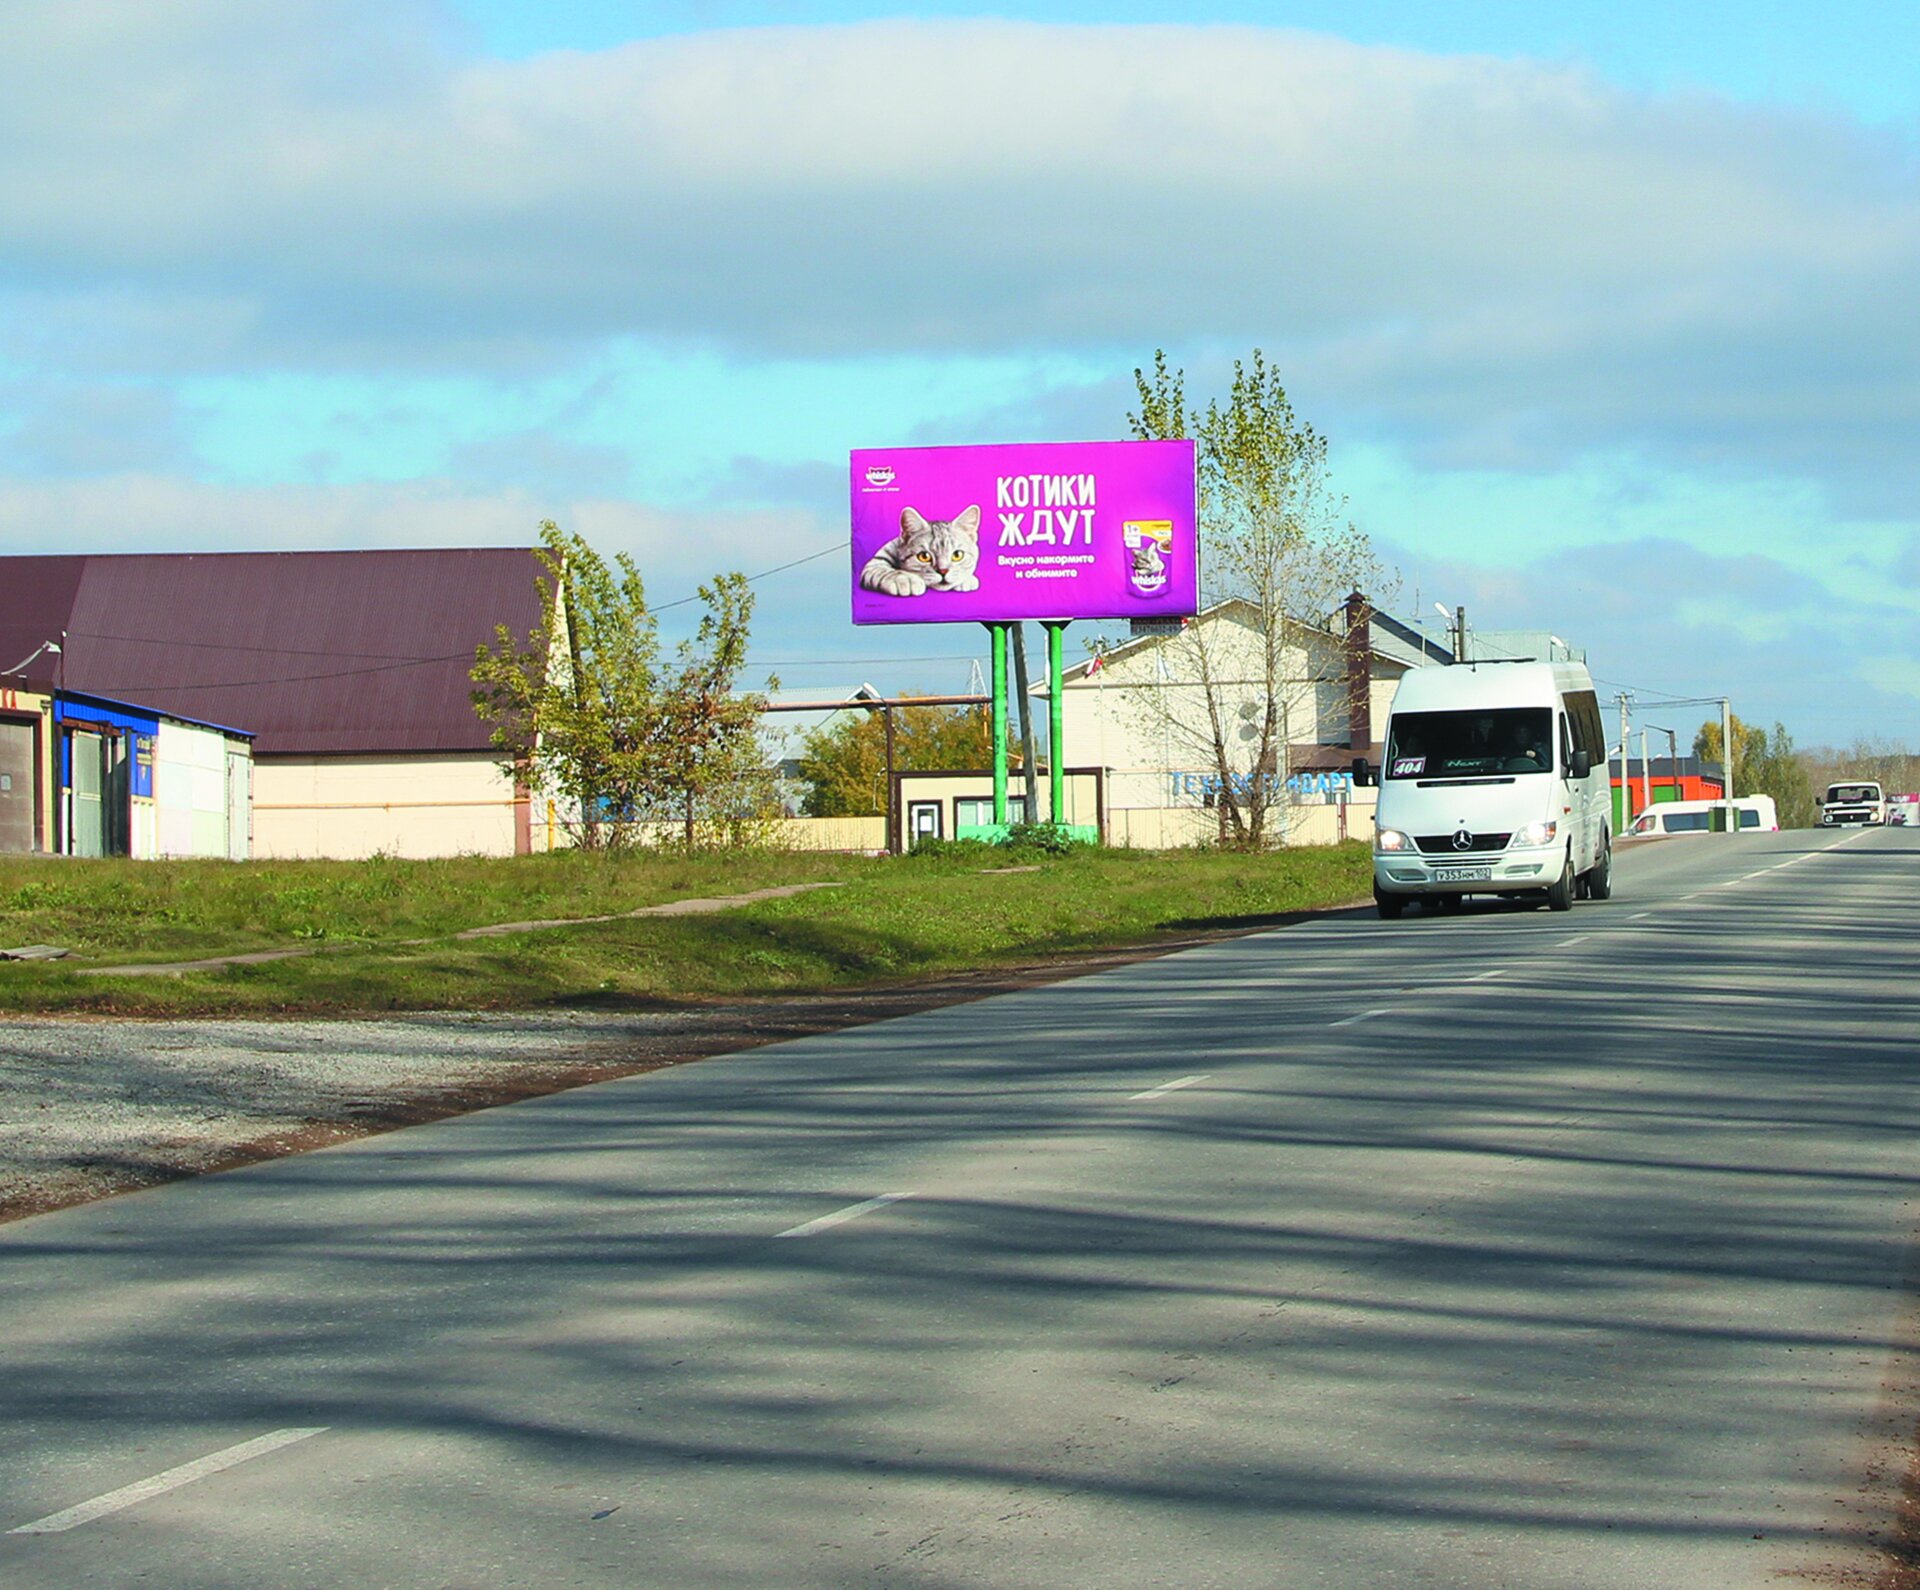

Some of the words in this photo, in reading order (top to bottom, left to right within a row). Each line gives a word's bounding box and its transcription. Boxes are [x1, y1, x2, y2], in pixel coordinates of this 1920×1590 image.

[997, 474, 1096, 508] КОТИКИ
[997, 509, 1096, 546] ЖДУТ
[998, 555, 1034, 567] Вкусно
[1036, 555, 1094, 566] накормите
[1015, 570, 1023, 578] и
[1025, 568, 1077, 578] обнимите
[1395, 762, 1422, 774] 404
